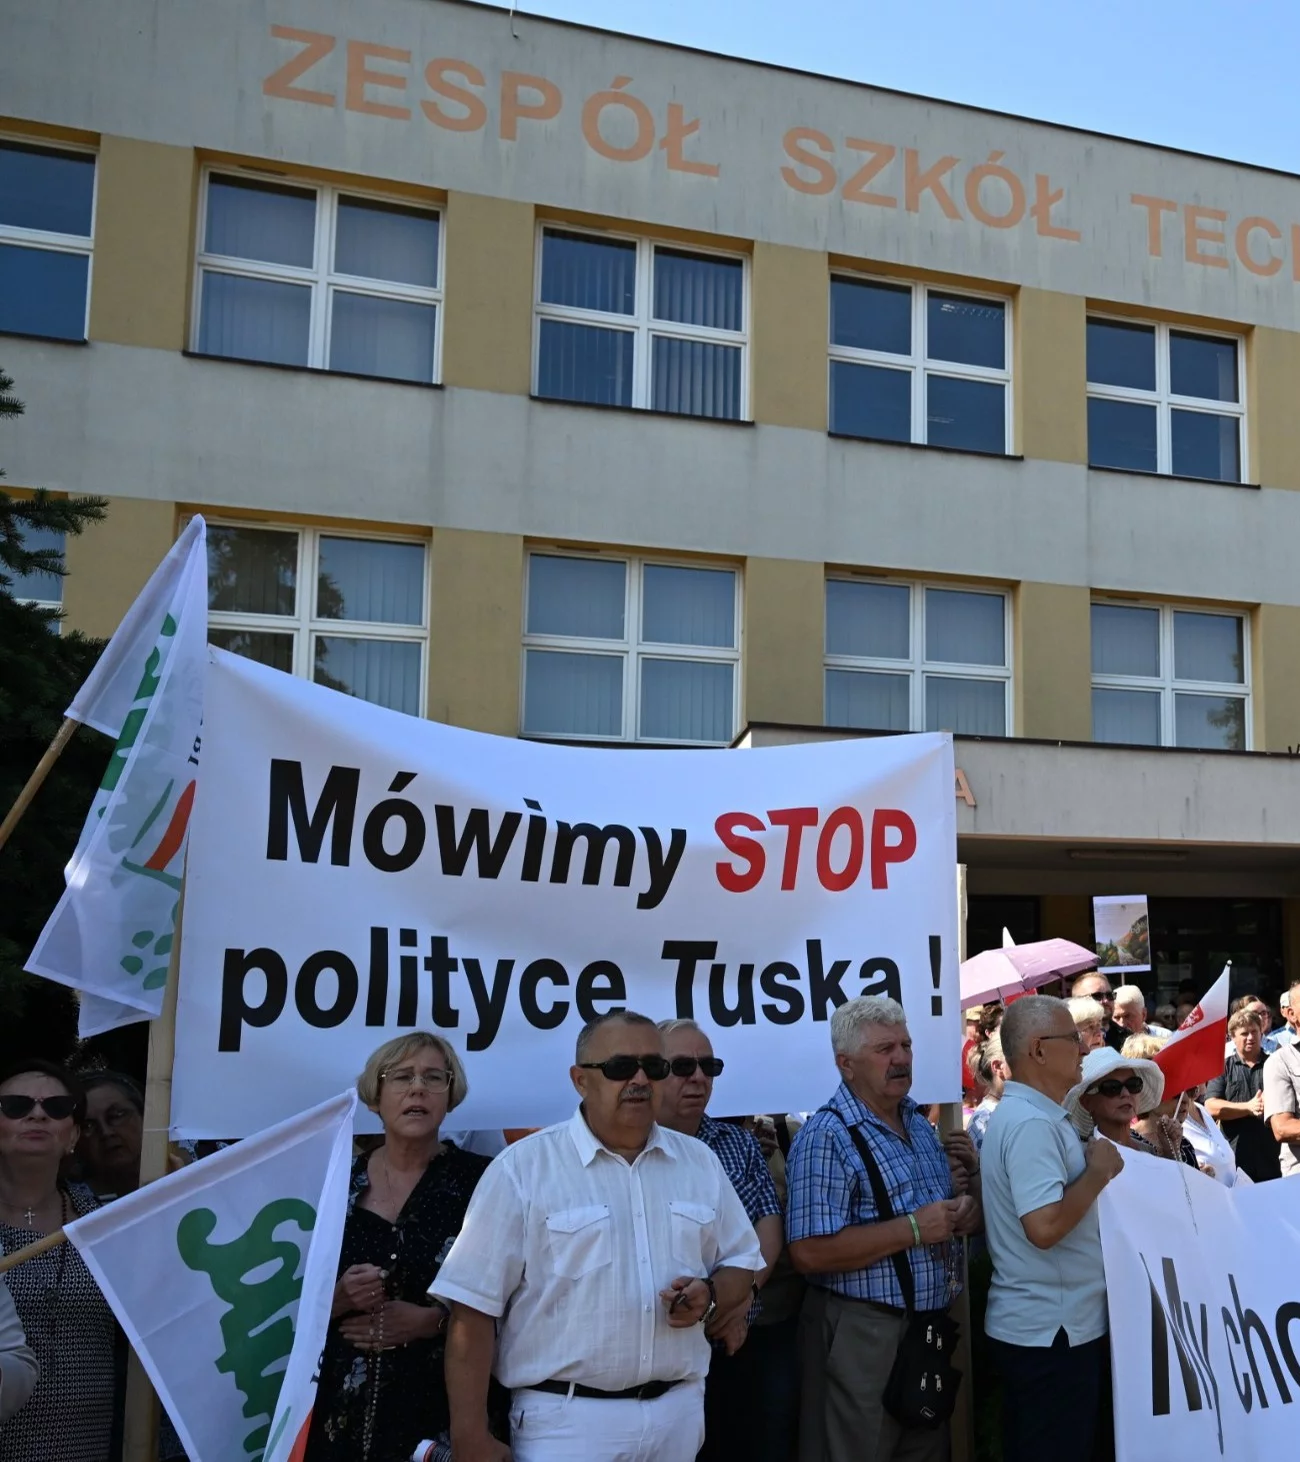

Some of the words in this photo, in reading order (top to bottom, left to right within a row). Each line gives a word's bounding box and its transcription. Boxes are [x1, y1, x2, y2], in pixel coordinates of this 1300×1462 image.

[262, 24, 720, 178] ZESPÓŁ
[780, 126, 1081, 242] SZKÓŁ
[266, 758, 686, 910] Mówimy
[715, 806, 917, 893] STOP
[956, 769, 976, 807] A
[218, 926, 626, 1052] polityce
[661, 939, 903, 1026] Tuska
